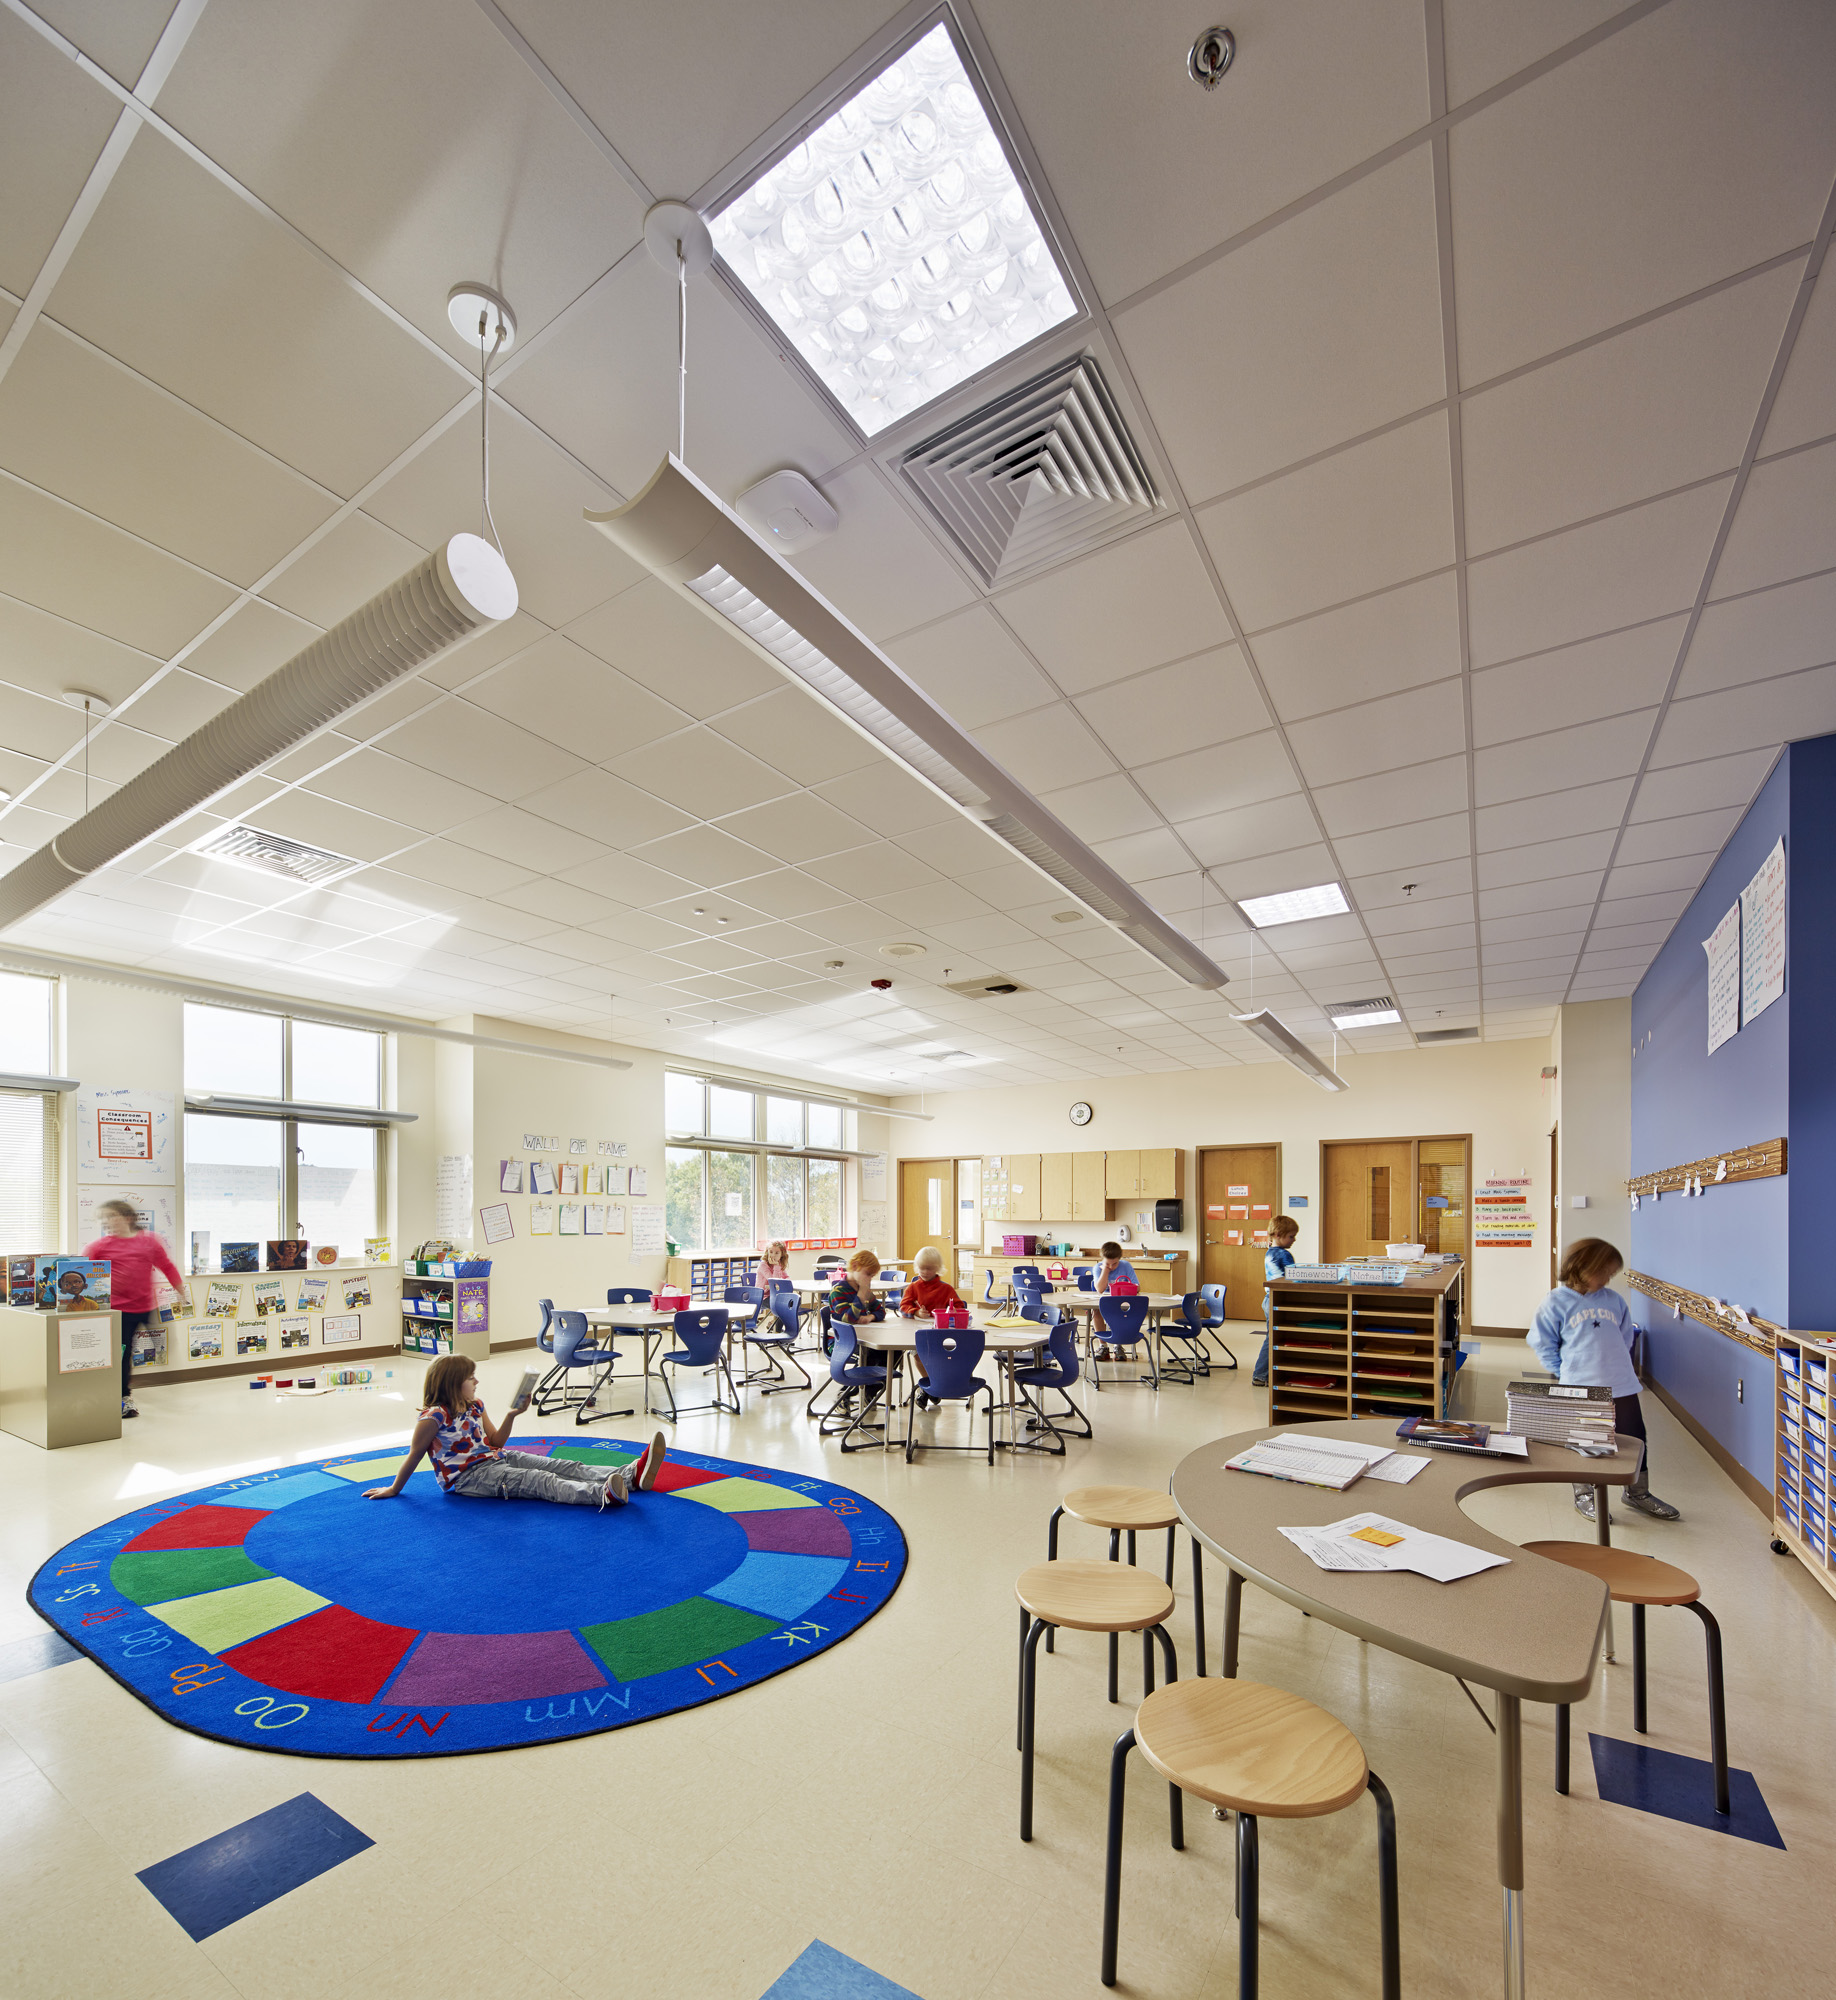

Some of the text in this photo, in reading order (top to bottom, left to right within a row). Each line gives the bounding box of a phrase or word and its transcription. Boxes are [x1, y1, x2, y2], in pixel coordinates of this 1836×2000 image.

[525, 1137, 626, 1154] WALL OF FAME
[342, 1275, 367, 1285] MYSTERY
[1287, 1269, 1336, 1279] Homework
[1353, 1271, 1381, 1281] Notes
[211, 1282, 242, 1290] REALISTIC
[1569, 1308, 1597, 1328] CAPE
[591, 1441, 622, 1450] Bb
[316, 1457, 357, 1468] Xx
[688, 1459, 728, 1470] Dd
[215, 1473, 280, 1490] Ww
[741, 1469, 772, 1480] Ee
[791, 1481, 823, 1492] Ff
[138, 1501, 190, 1517] Vv
[828, 1497, 863, 1516] Gg
[856, 1526, 887, 1546] Hh
[56, 1560, 101, 1577] Tt
[853, 1560, 890, 1573] Ii
[55, 1583, 101, 1603] Ss
[827, 1588, 869, 1605] Jj
[80, 1606, 129, 1627] Rr
[119, 1623, 173, 1658] Qq
[770, 1620, 831, 1647] Kk
[170, 1663, 226, 1696] Pp
[695, 1660, 739, 1687] Ll
[234, 1696, 310, 1730] Oo
[524, 1687, 632, 1723] Mm
[365, 1712, 451, 1739] Nn
